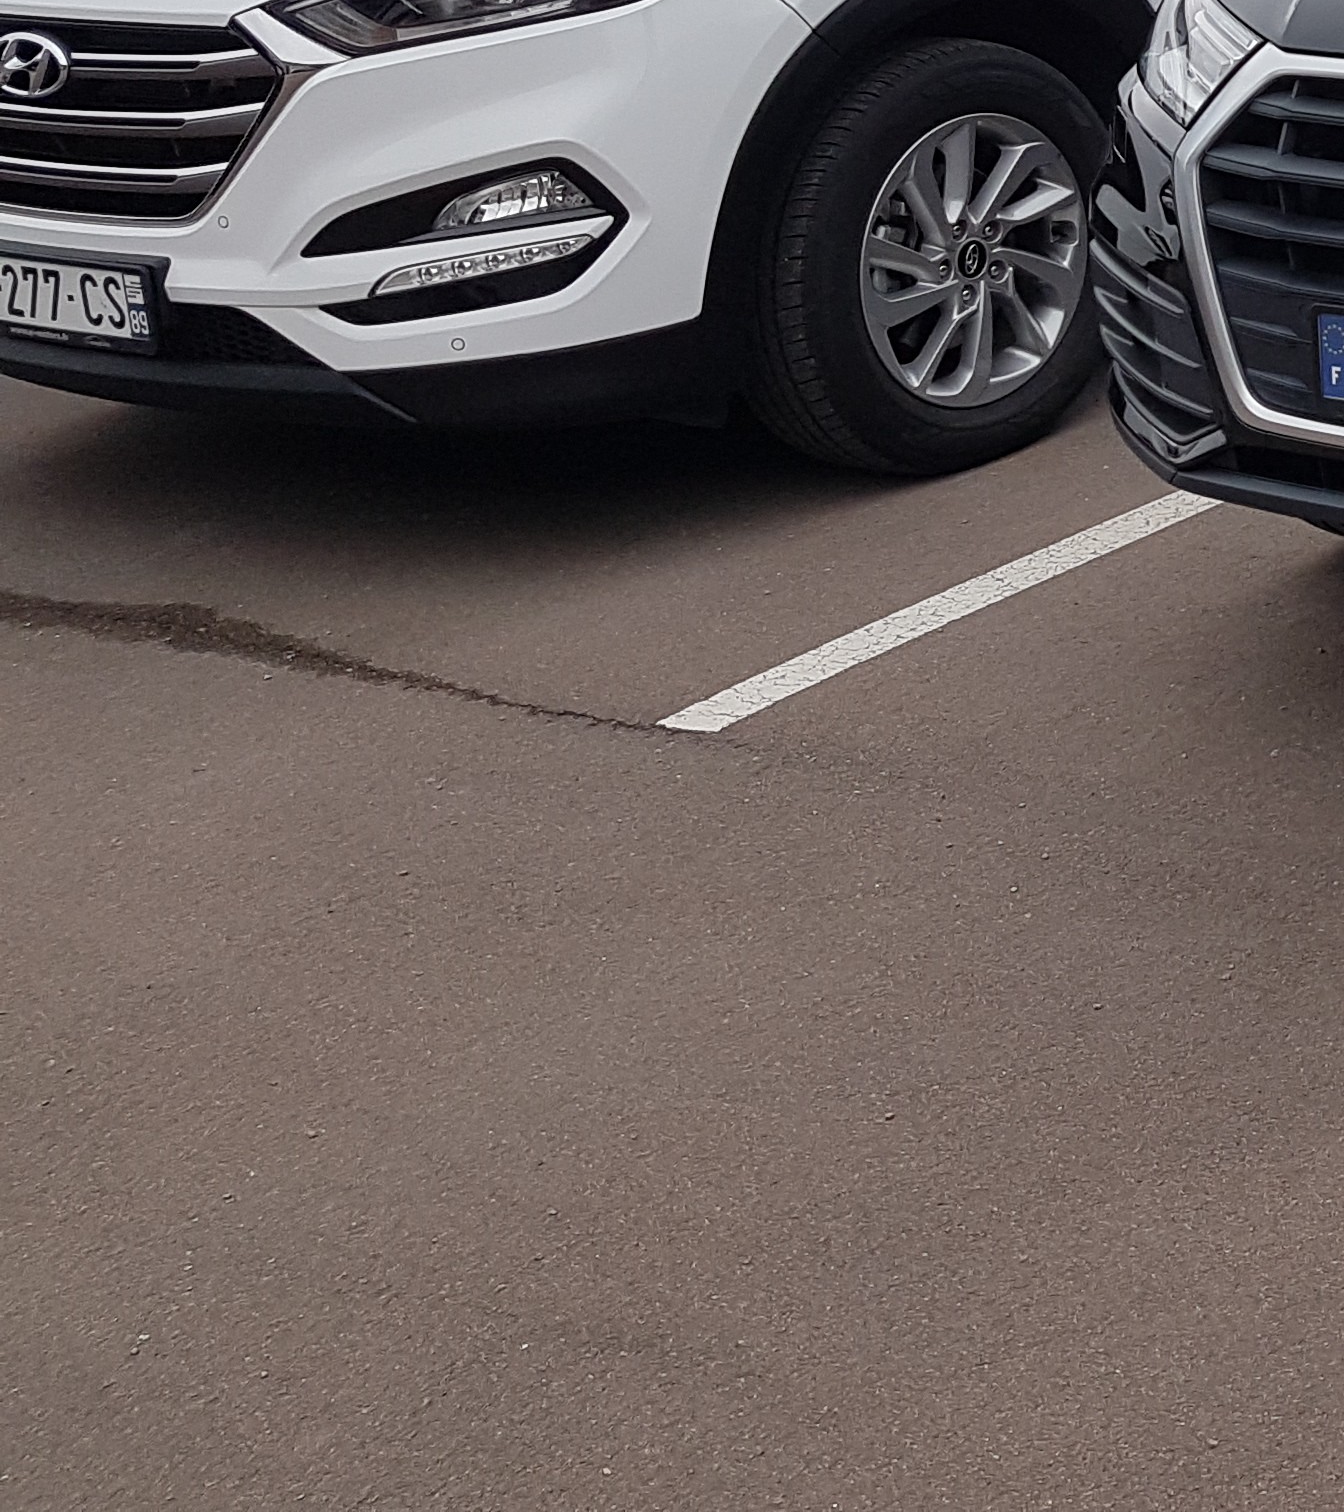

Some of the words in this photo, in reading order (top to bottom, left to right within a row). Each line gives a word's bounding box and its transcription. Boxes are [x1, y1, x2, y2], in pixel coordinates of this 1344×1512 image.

[0, 263, 126, 330] 277-CS
[129, 309, 150, 335] 89
[1331, 365, 1342, 386] F
